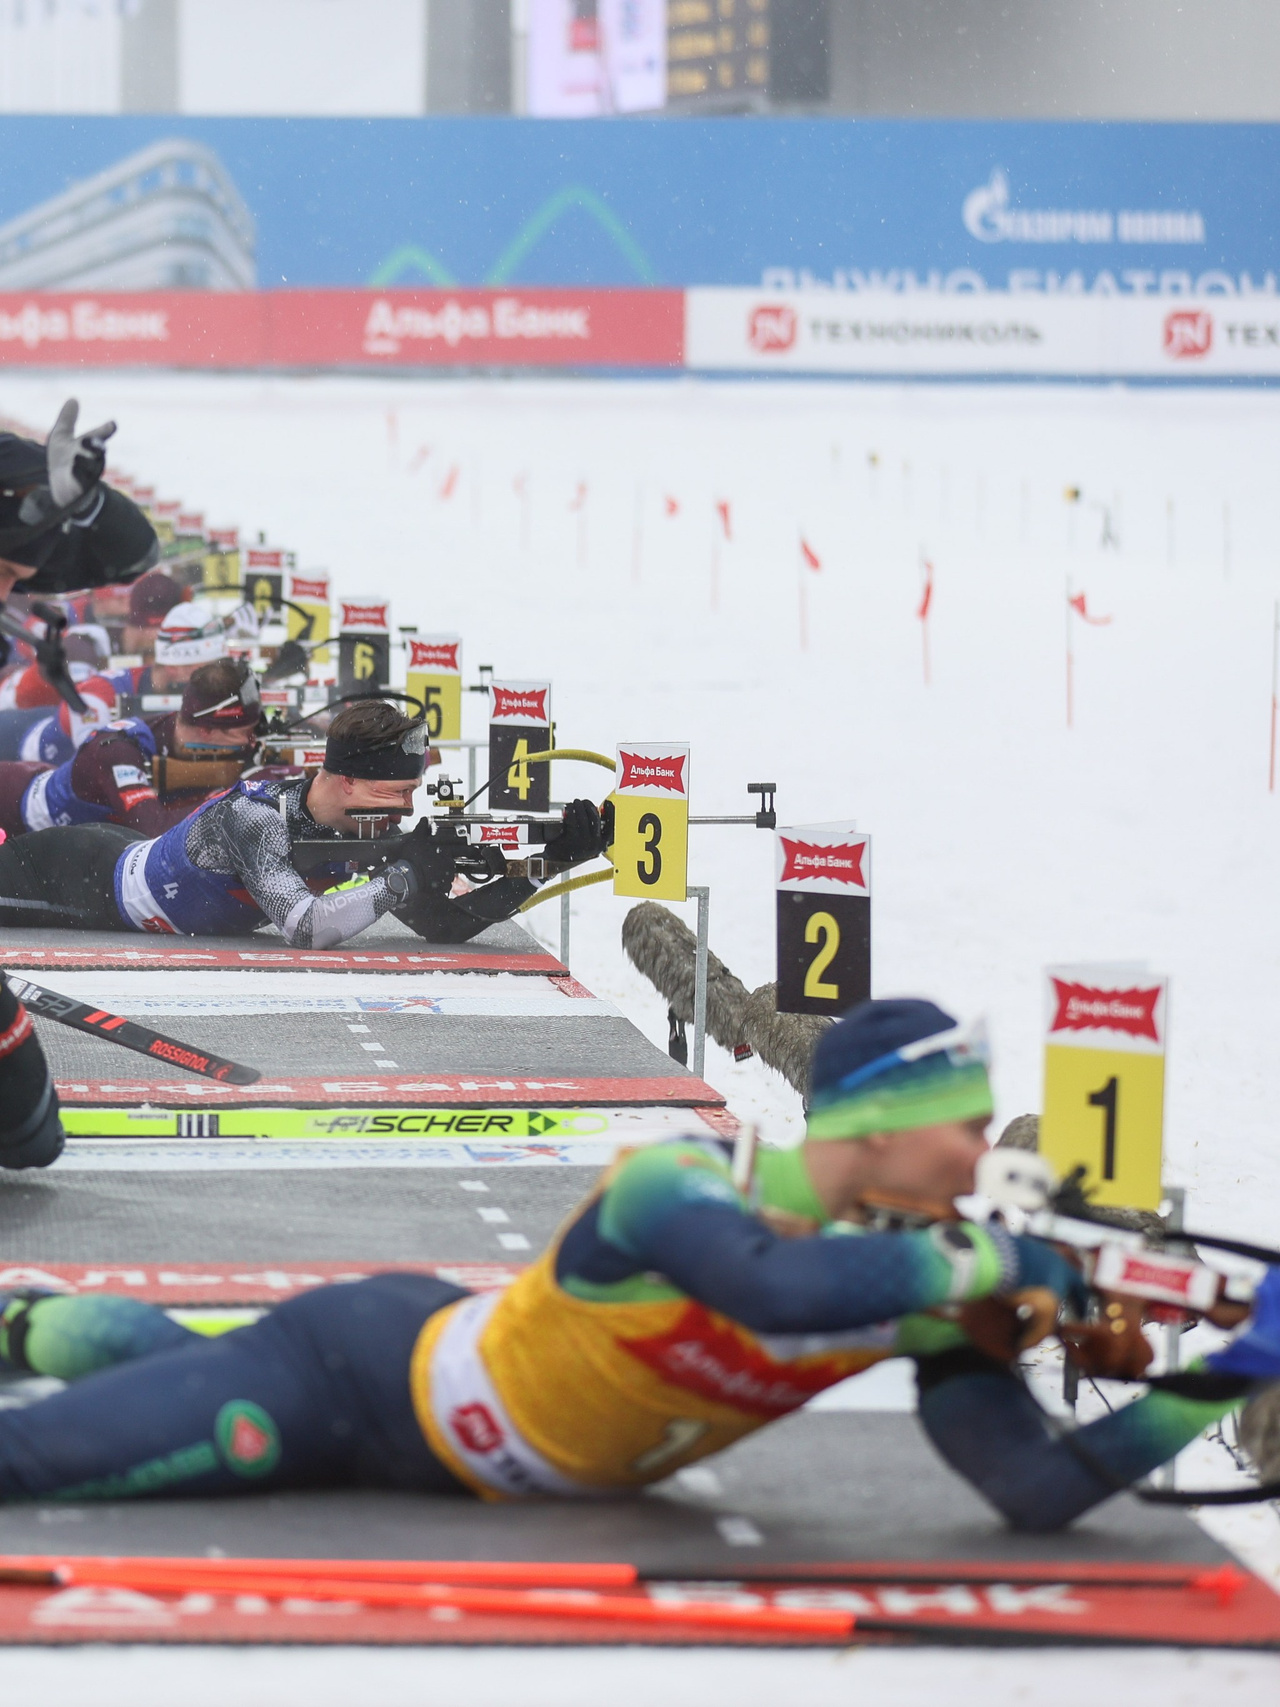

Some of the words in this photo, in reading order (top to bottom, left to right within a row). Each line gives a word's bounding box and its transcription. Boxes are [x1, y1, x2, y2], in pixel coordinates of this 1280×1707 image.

[74, 304, 169, 342] Банк
[365, 301, 489, 354] Альфа
[496, 302, 590, 343] Банк
[808, 319, 1044, 347] ТЕХНОНИКОЛЬ
[353, 642, 374, 681] 6
[424, 686, 442, 738] 5
[501, 695, 521, 709] Альфа
[521, 698, 538, 709] Банк
[507, 738, 531, 801] 4
[630, 764, 655, 779] Альфа
[655, 766, 675, 778] Банк
[636, 812, 662, 885] 3
[793, 853, 826, 870] Альфа
[826, 855, 853, 869] Банк
[163, 881, 179, 900] 4
[803, 911, 841, 1000] 2
[149, 1039, 208, 1073] ROSSIGNOL
[56, 1083, 298, 1096] льфа
[326, 1114, 514, 1134] FISCHER
[1086, 1075, 1119, 1181] 1
